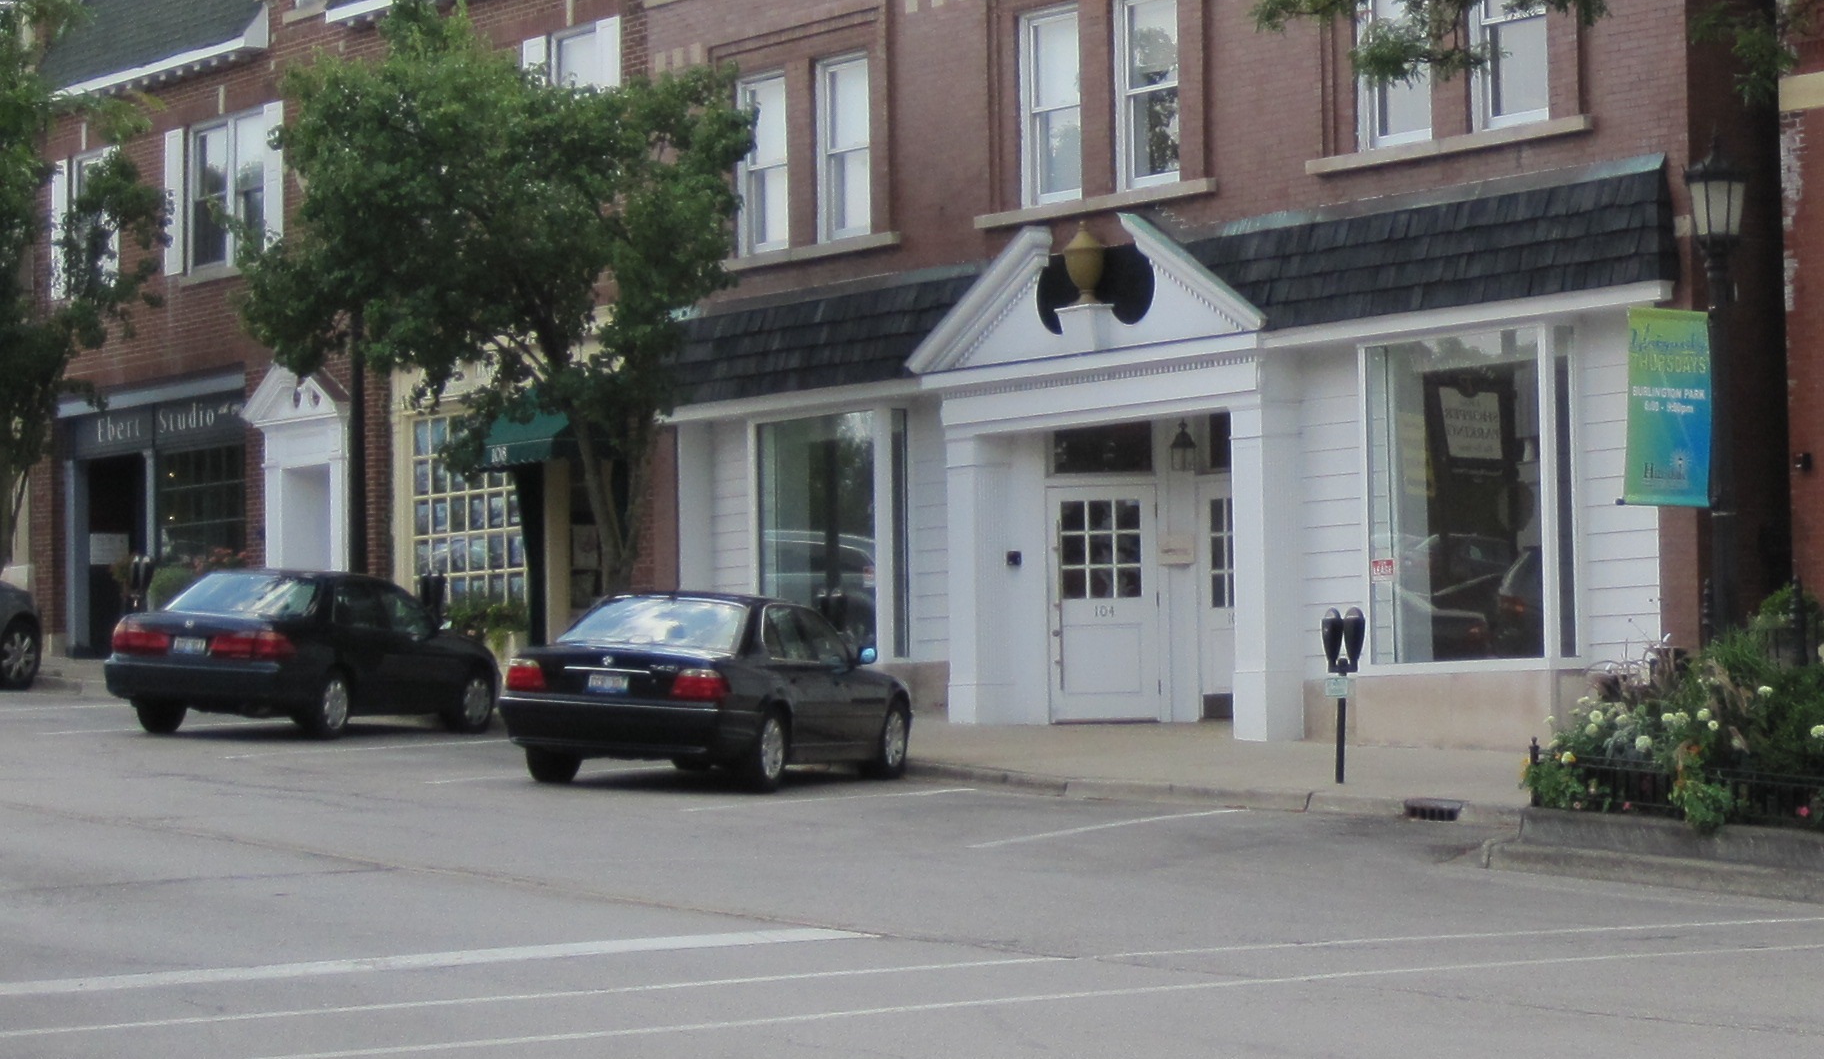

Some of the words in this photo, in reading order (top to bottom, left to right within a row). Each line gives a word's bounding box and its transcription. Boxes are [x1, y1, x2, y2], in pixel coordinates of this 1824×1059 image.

[1630, 351, 1706, 374] THURSDAYS
[1632, 386, 1682, 399] BURLINGTON
[1683, 388, 1706, 400] PARK
[97, 415, 141, 442] Ebert
[159, 402, 215, 433] Studio
[1094, 605, 1115, 618] 104
